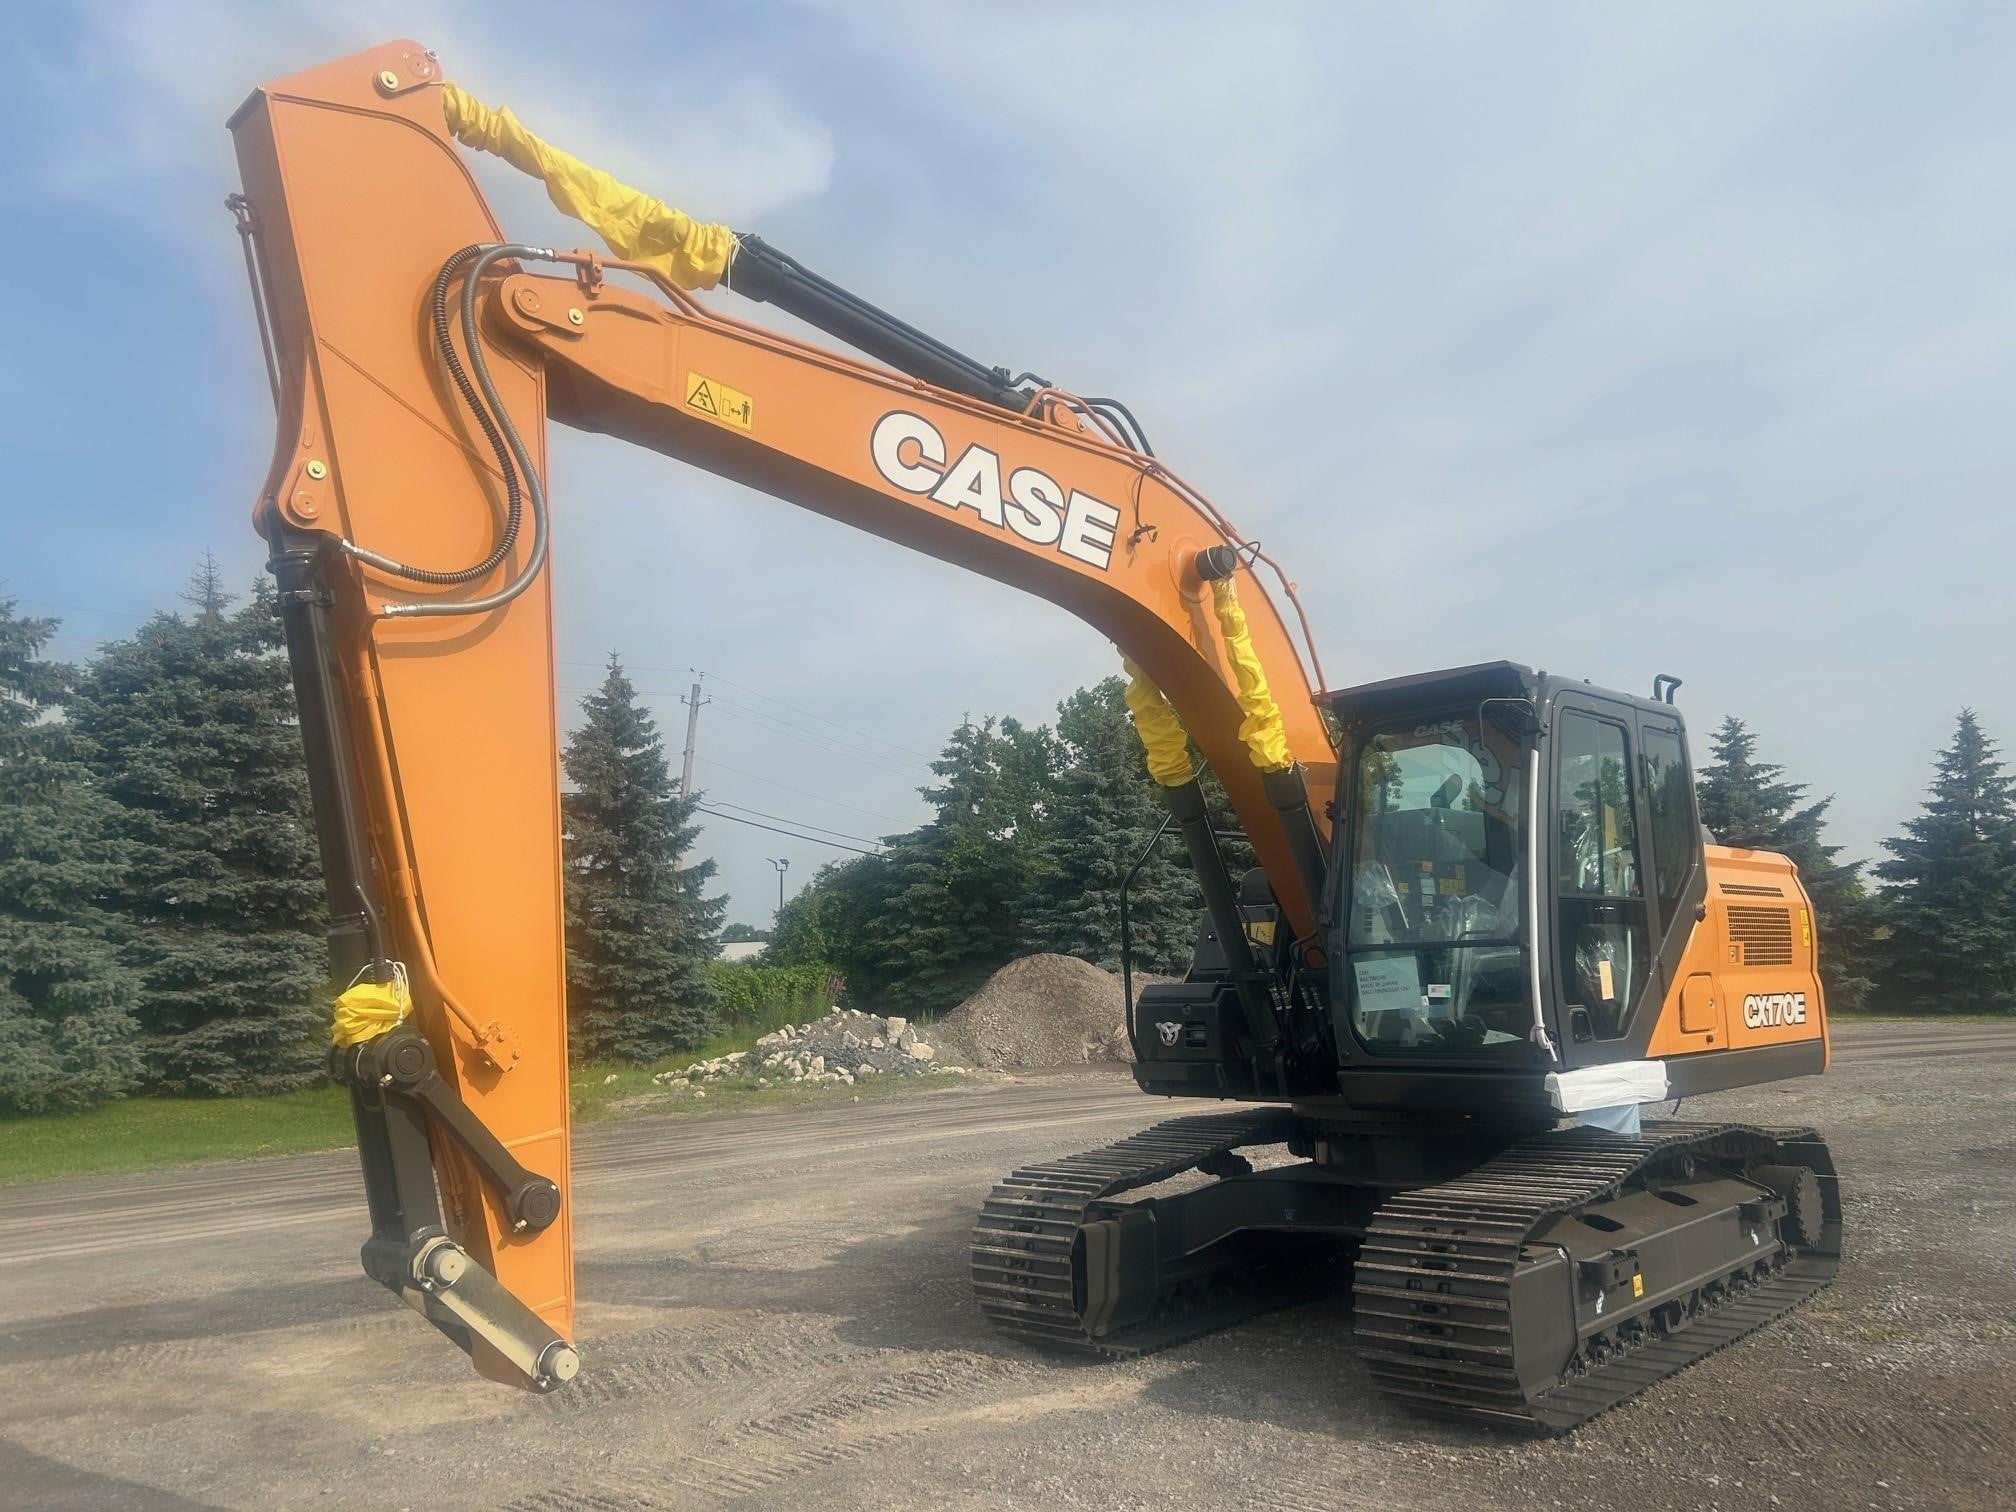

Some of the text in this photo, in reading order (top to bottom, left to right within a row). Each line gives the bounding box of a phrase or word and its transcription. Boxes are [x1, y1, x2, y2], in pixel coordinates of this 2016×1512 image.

[870, 409, 1121, 572] CASE
[1413, 721, 1464, 737] CASE
[1743, 992, 1806, 1029] CX170E
